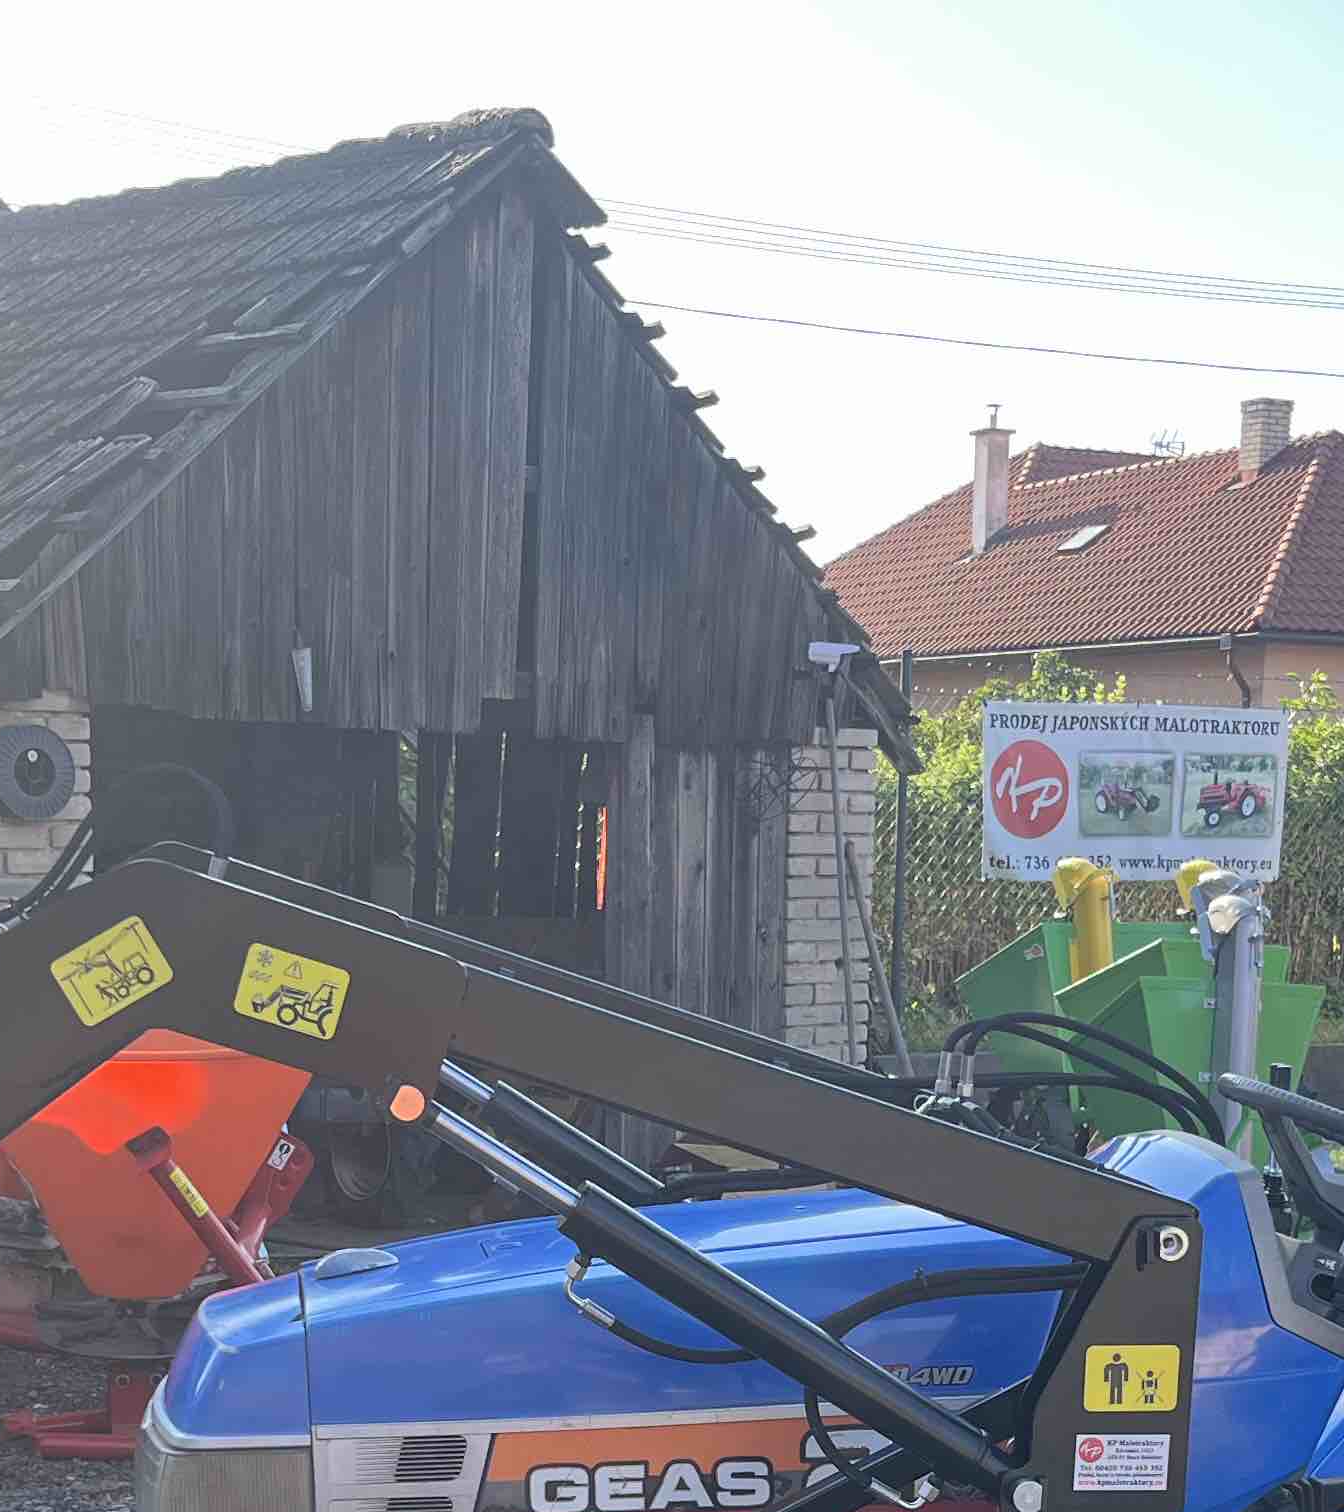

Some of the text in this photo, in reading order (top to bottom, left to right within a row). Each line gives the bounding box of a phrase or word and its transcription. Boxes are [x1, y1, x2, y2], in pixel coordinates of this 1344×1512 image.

[990, 713, 1048, 733] PRODEJ
[1024, 855, 1050, 870] 736
[910, 1365, 974, 1386] 4WD
